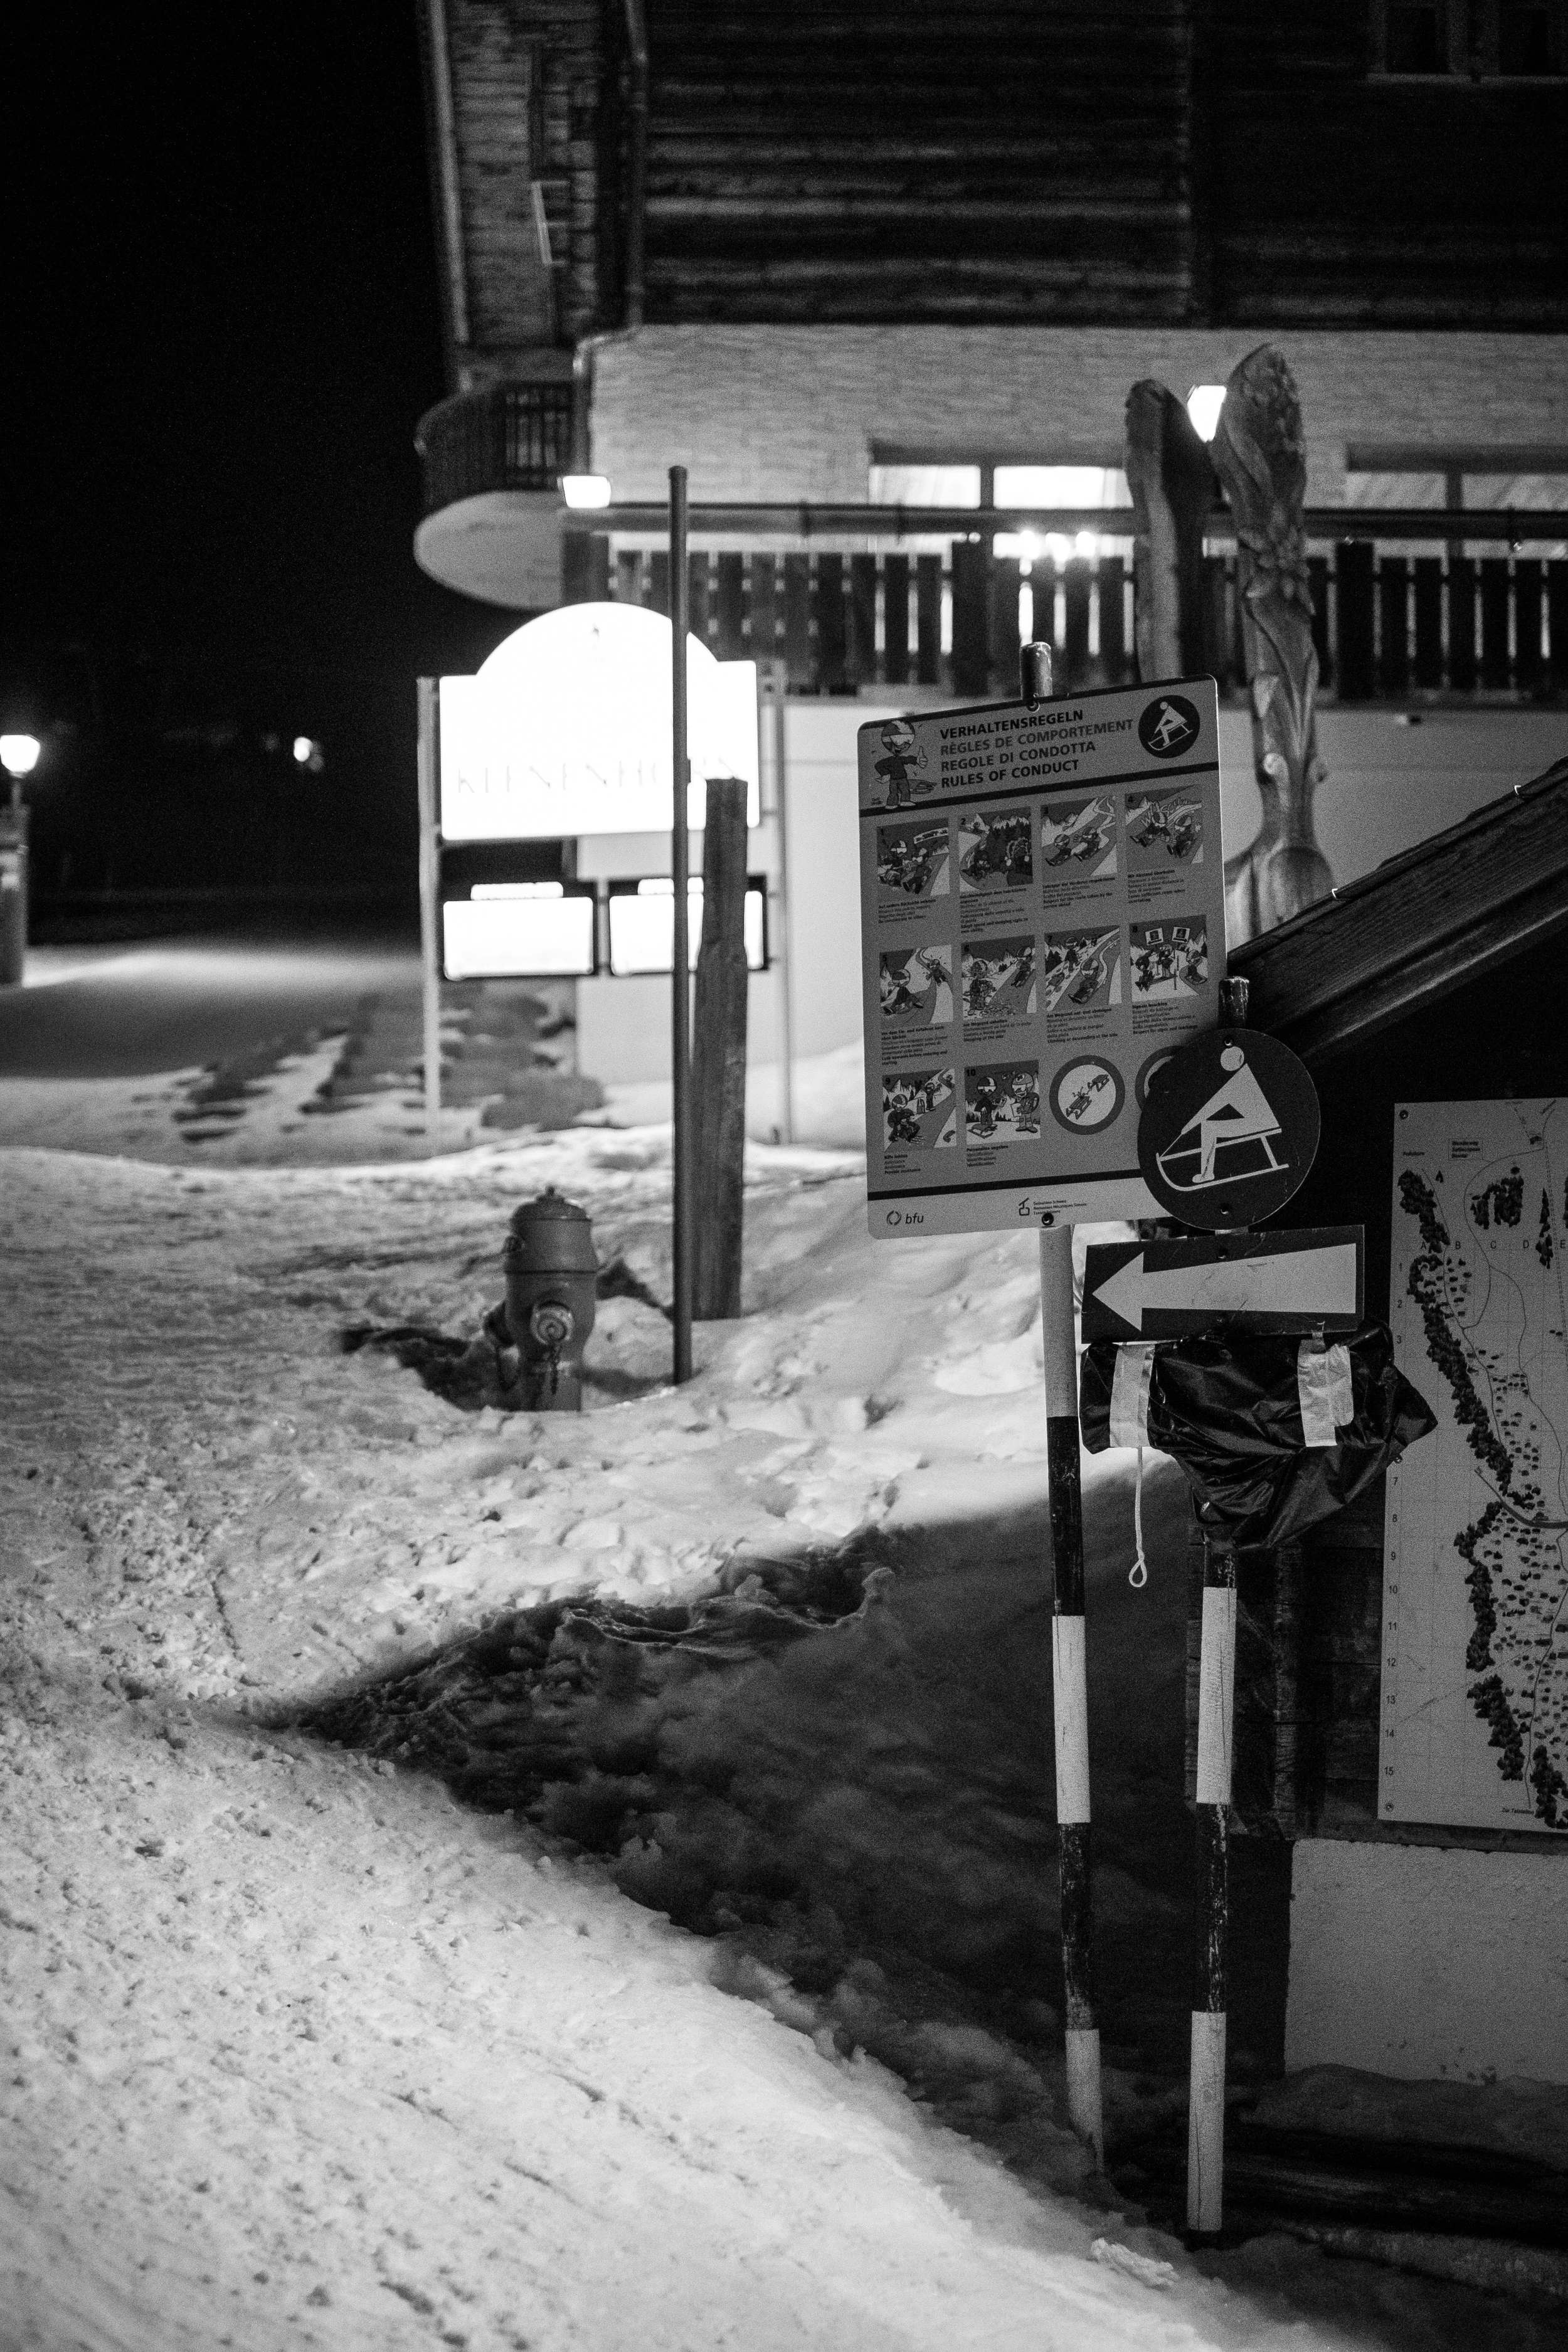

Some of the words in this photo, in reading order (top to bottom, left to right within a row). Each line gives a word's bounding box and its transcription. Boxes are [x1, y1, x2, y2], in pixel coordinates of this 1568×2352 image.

[940, 709, 1083, 739] VERHALTENSREGELN
[941, 739, 990, 755] RÈGLES
[995, 736, 1013, 748] DE
[1017, 719, 1133, 744] COMPORTEMENT
[941, 755, 993, 771] REGOLE
[1000, 753, 1013, 763] DI
[1019, 741, 1096, 761] CONDOTTA
[941, 773, 983, 788] RULES
[988, 769, 1006, 781] OF
[1012, 760, 1079, 778] CONDUCT
[967, 1068, 976, 1076] 10
[905, 1212, 924, 1224] bfu
[1420, 1242, 1427, 1250] A
[1455, 1241, 1461, 1249] B
[1490, 1241, 1496, 1249] C
[1523, 1240, 1529, 1249] D
[1560, 1240, 1566, 1249] E
[1399, 1263, 1402, 1271] 1
[1397, 1300, 1402, 1308] 2
[1397, 1335, 1402, 1344] 3
[1393, 1476, 1398, 1486] 7
[1392, 1513, 1397, 1523] 8
[1391, 1551, 1396, 1560] 9
[1389, 1585, 1397, 1594] 10
[1389, 1621, 1397, 1631] 11
[1387, 1657, 1396, 1667] 12
[1386, 1695, 1396, 1705] 13
[1386, 1729, 1394, 1738] 14
[1384, 1766, 1393, 1776] 15
